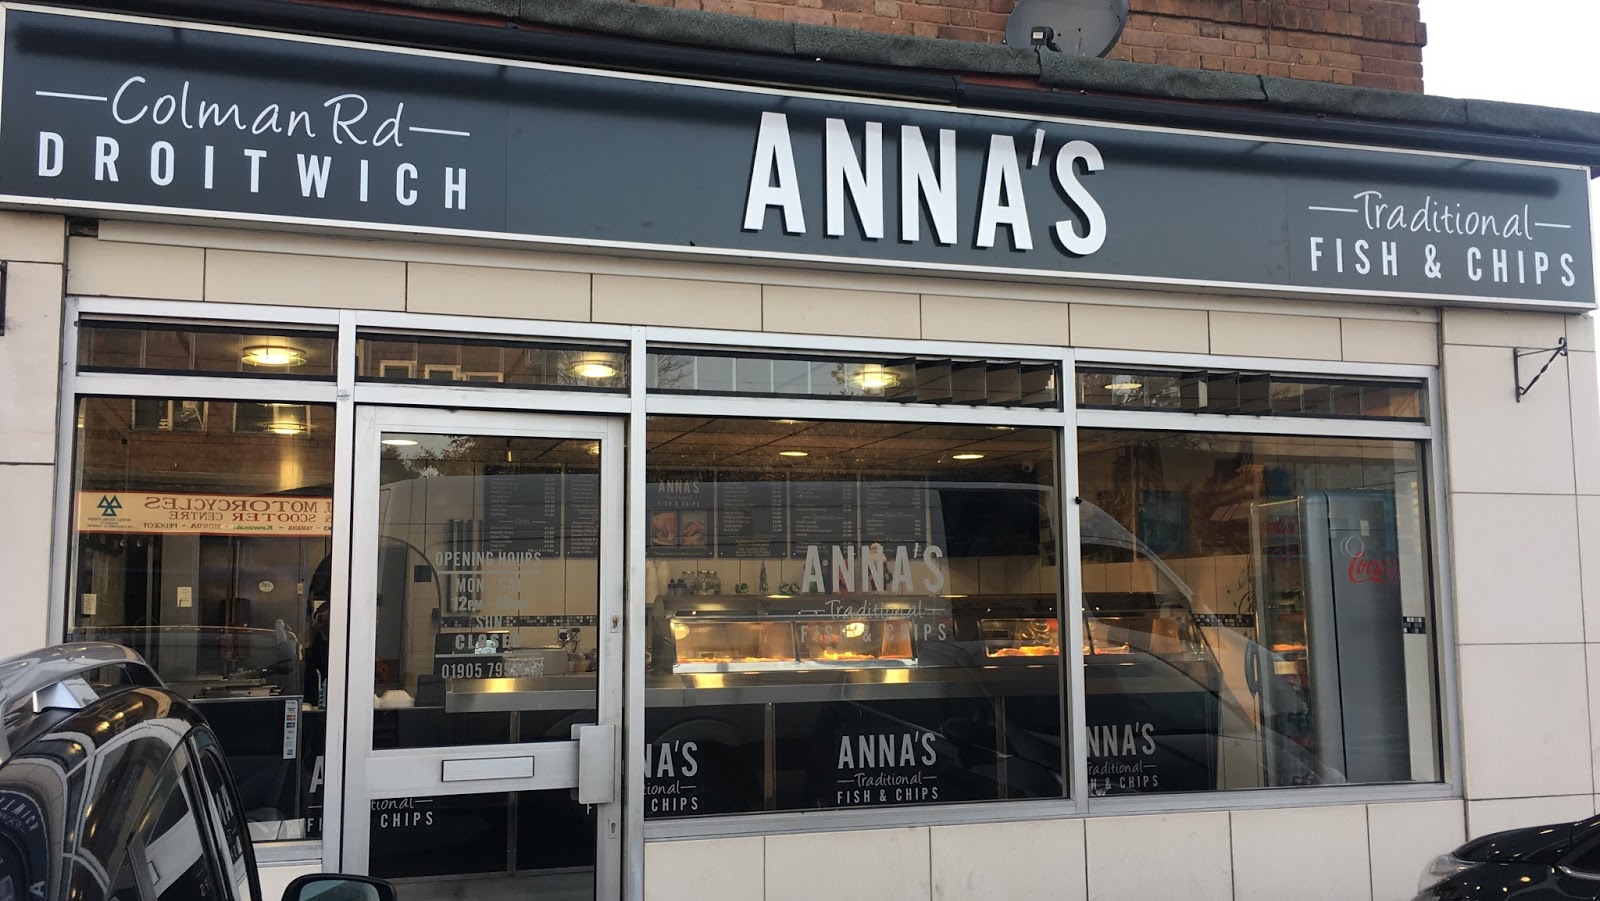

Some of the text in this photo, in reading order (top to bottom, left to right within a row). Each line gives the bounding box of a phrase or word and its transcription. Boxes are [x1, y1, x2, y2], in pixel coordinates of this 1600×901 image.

[111, 76, 404, 147] Colman Rd
[38, 131, 468, 210] DROITWICH
[742, 111, 1107, 256] ANNA'S
[1353, 190, 1533, 241] Traditional
[1310, 236, 1576, 287] FISH & CHIPS
[435, 551, 542, 567] OPENING HOURS
[801, 542, 945, 593] ANNA'S
[456, 577, 485, 593] MON
[475, 615, 503, 628] SUN
[441, 663, 482, 679] 01905
[1086, 722, 1156, 758] NNA'S
[837, 731, 937, 769] ANNA'S
[854, 771, 923, 787] Traditional
[1120, 775, 1159, 789] CHIPS
[651, 796, 699, 812] CHIPS
[837, 786, 939, 805] FISH & CHIPS
[380, 811, 434, 828] CHIPS
